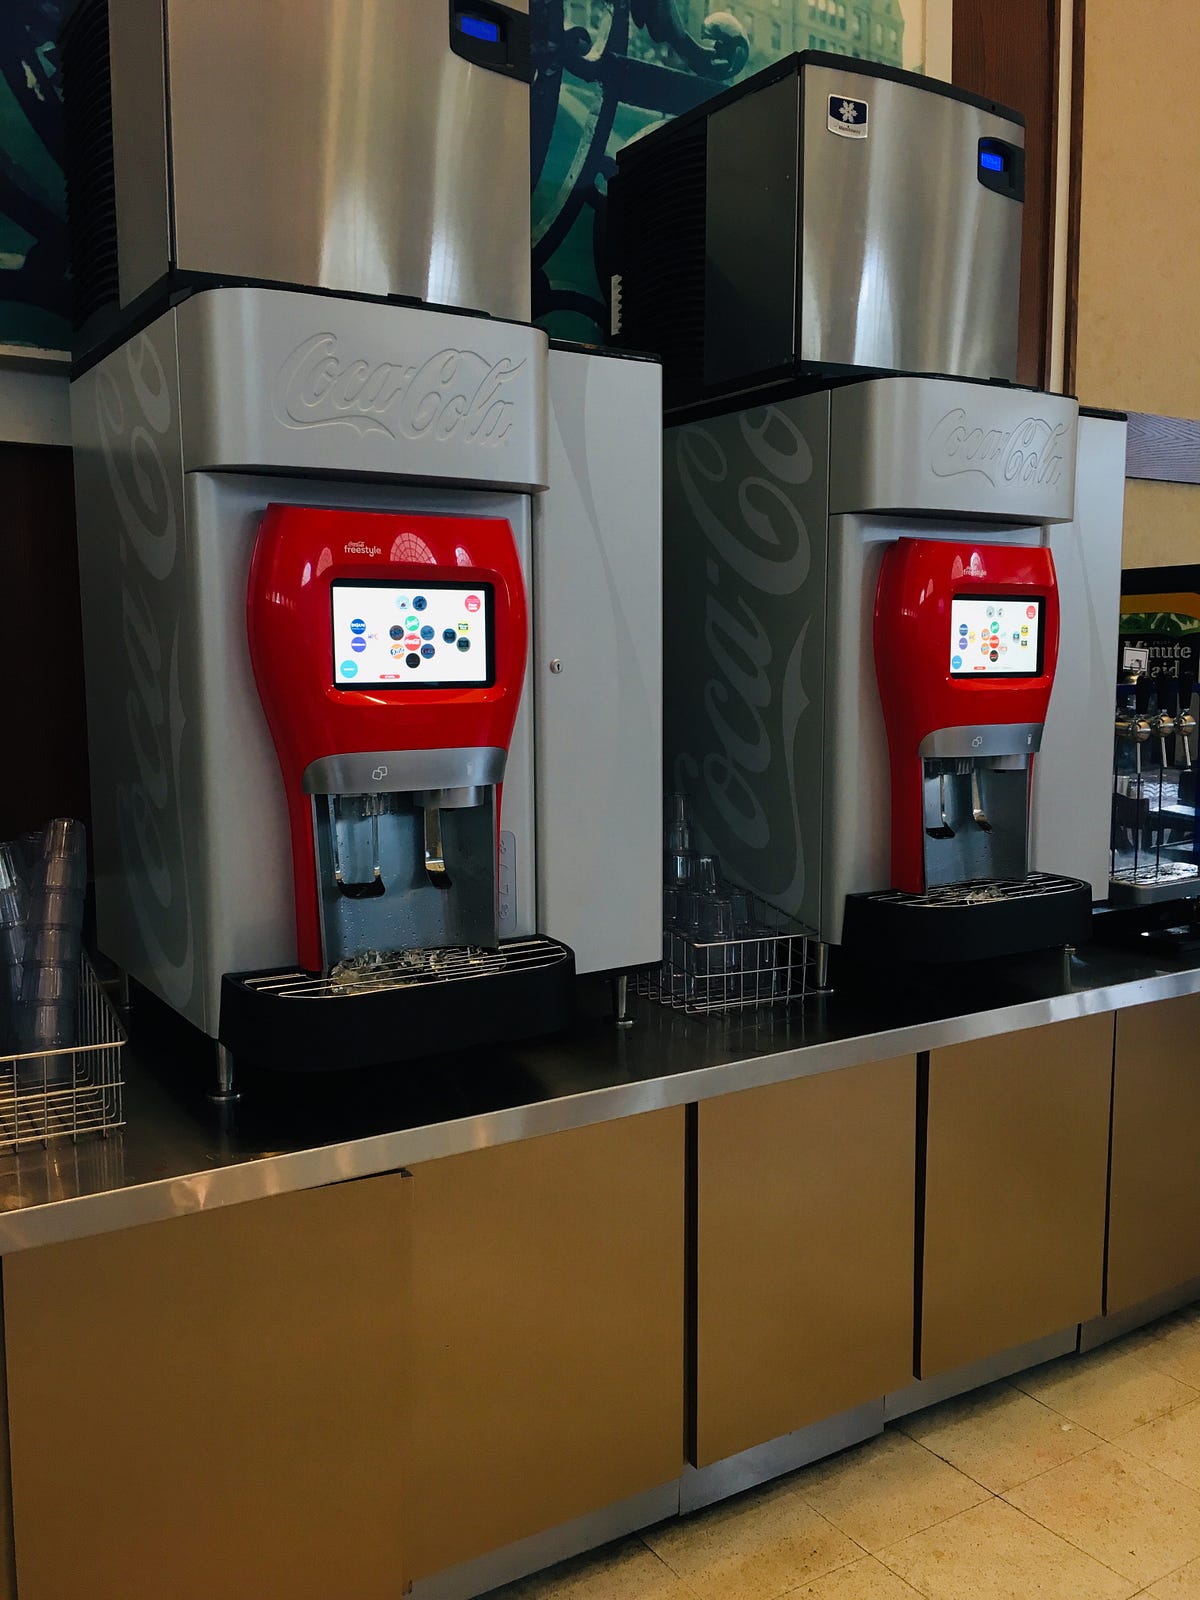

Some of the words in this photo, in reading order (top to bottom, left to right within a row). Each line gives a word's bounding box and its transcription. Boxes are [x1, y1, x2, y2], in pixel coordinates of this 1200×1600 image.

[272, 331, 527, 446] Coca-Cola
[927, 408, 1069, 487] Coca-Cola
[343, 544, 383, 557] freestyle
